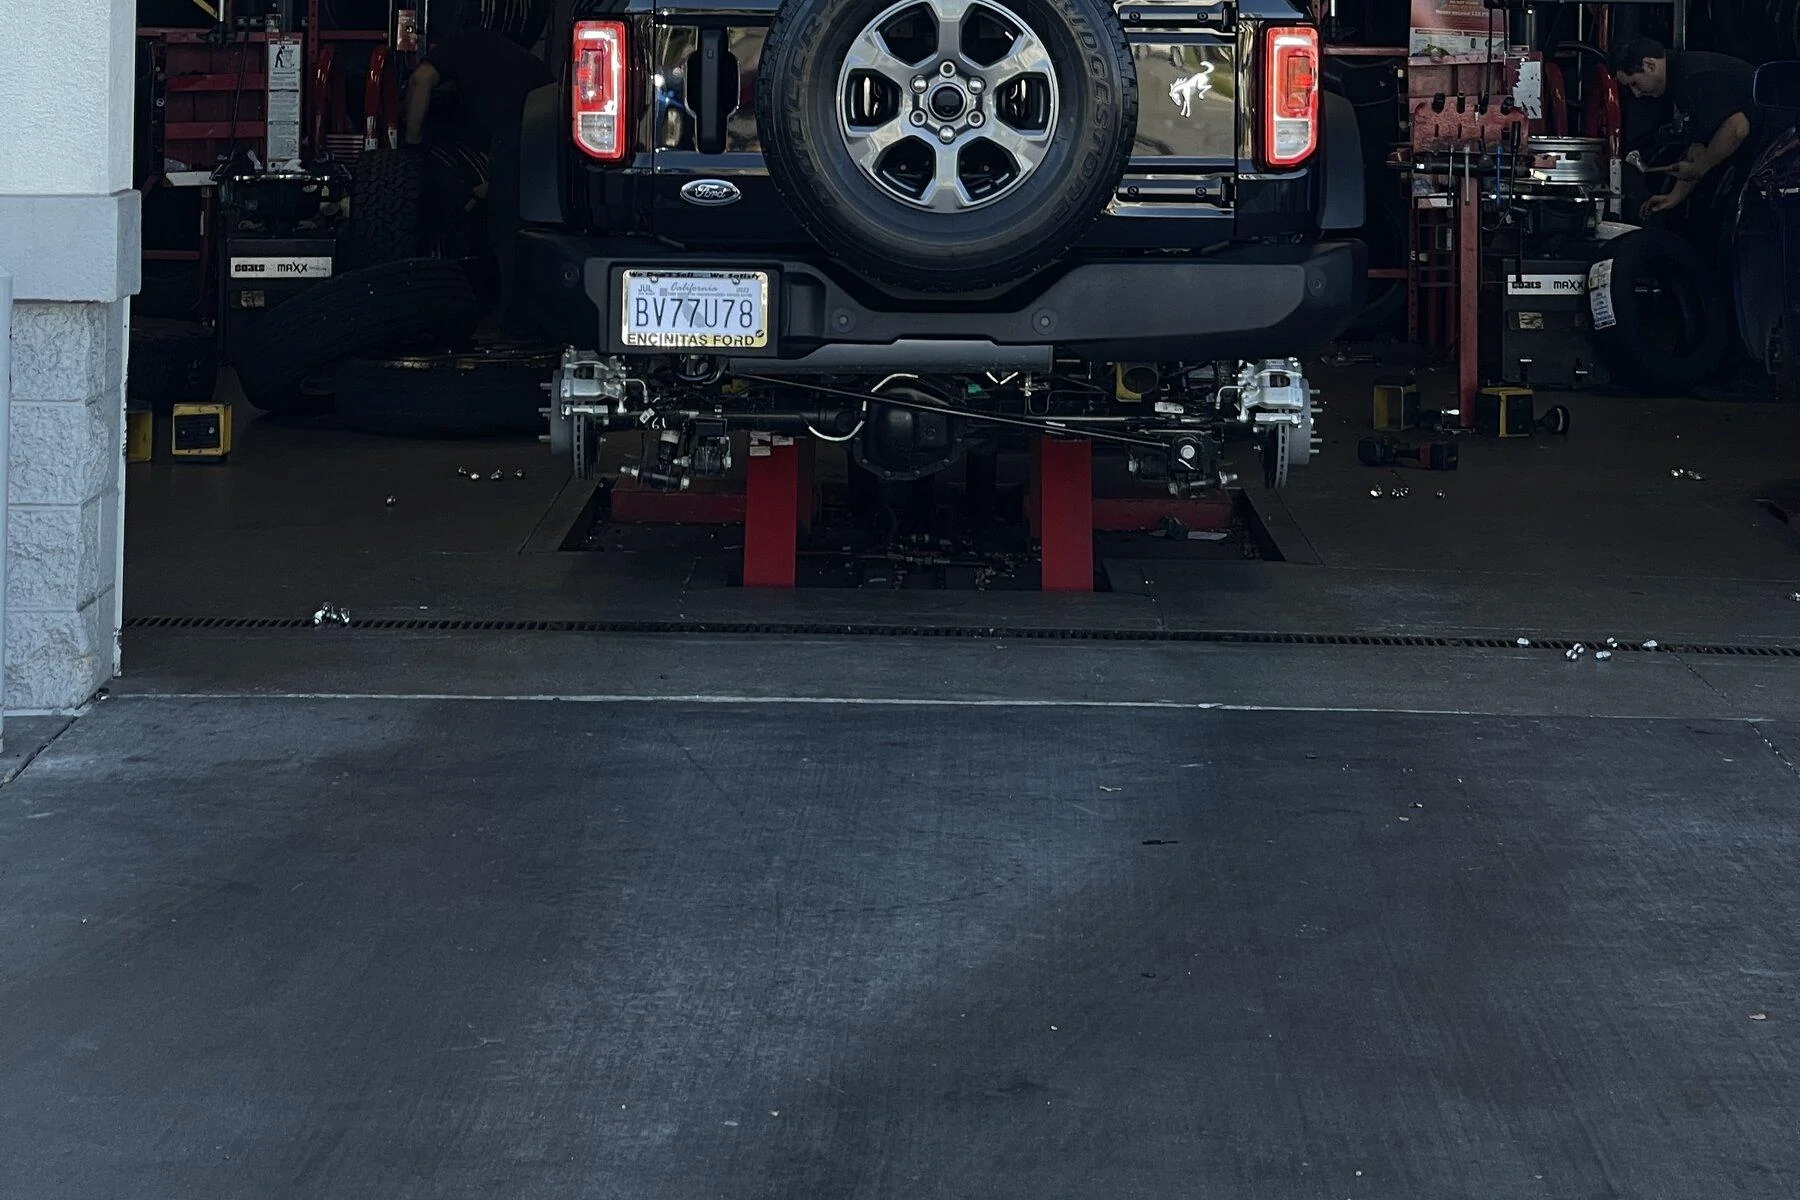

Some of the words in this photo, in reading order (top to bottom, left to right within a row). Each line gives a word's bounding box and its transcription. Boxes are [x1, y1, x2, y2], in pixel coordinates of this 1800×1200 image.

[695, 184, 727, 198] Ford
[638, 284, 653, 293] JUL
[670, 281, 718, 296] California
[635, 298, 753, 328] BV77U78
[627, 332, 708, 347] ENCINITAS
[713, 334, 755, 347] FORD
